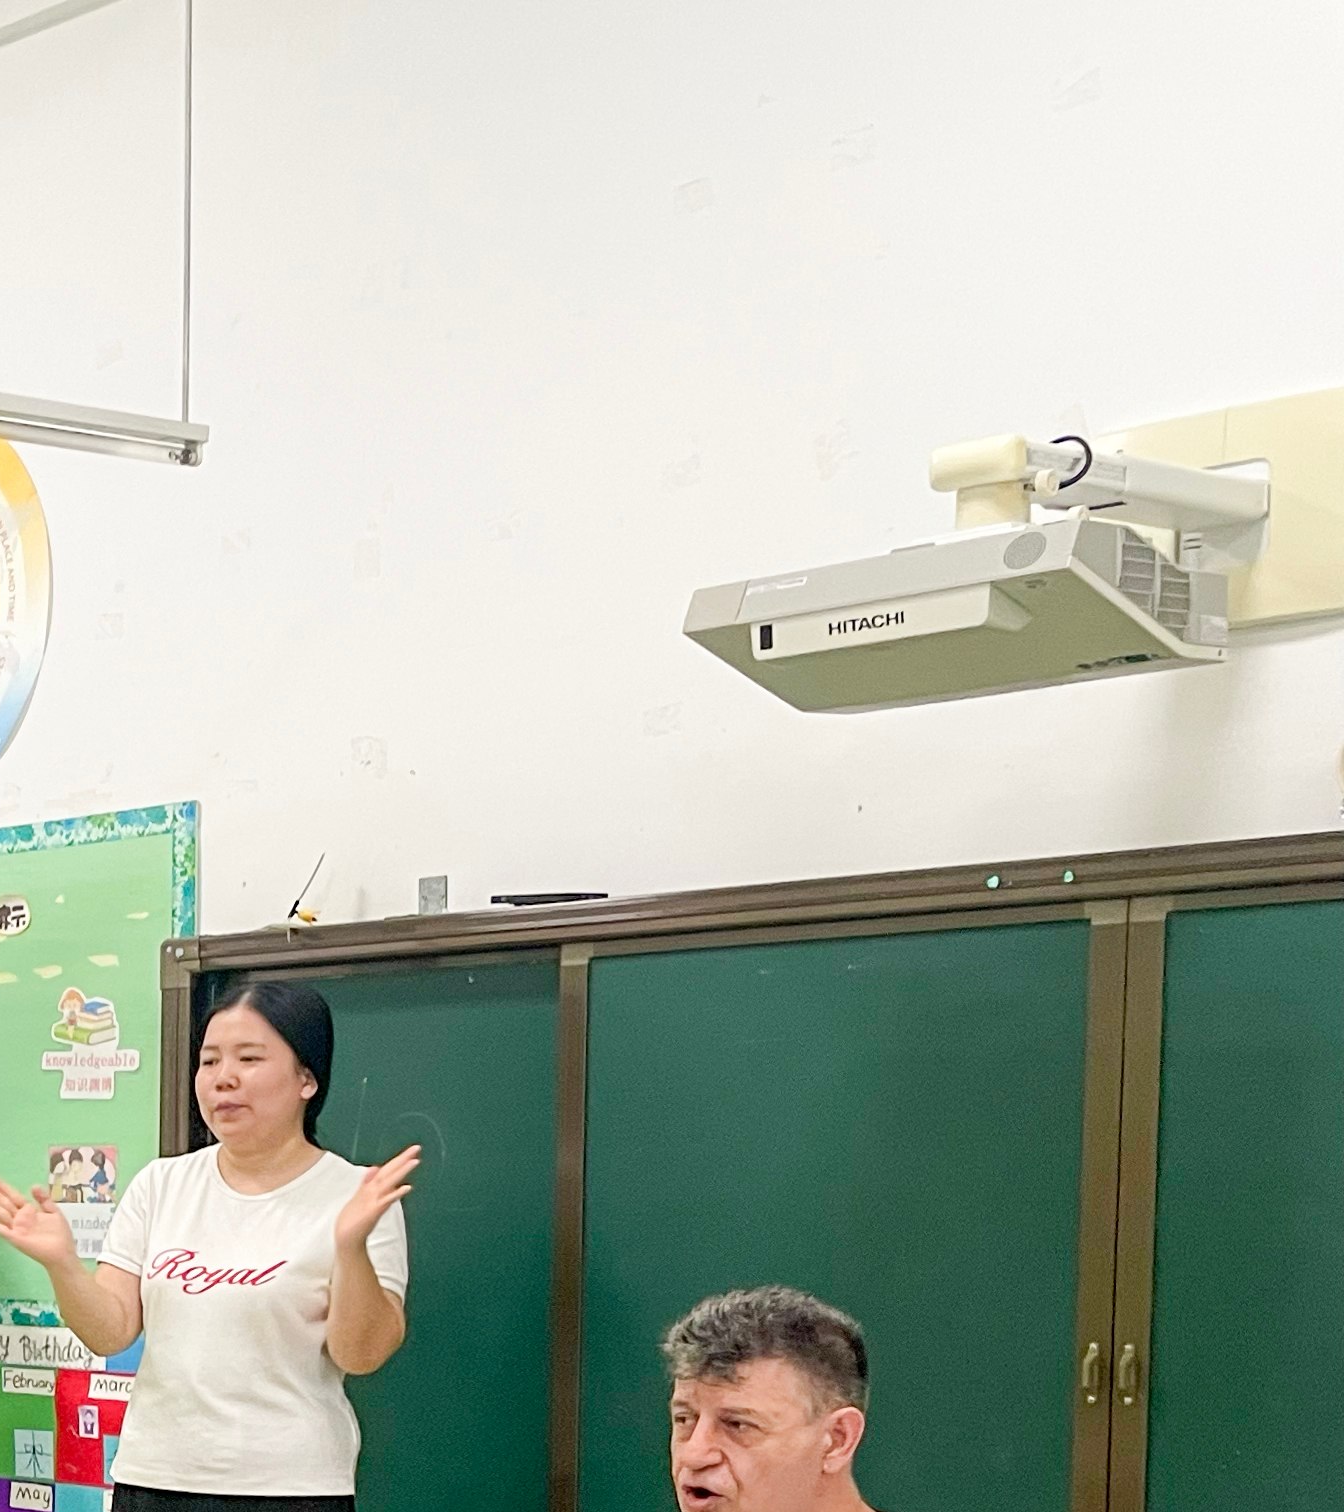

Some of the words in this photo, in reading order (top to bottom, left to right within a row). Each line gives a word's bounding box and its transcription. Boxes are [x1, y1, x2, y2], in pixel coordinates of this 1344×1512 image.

[828, 610, 904, 636] HITACHI
[146, 1248, 288, 1295] Royal
[3, 1368, 55, 1393] February
[93, 1379, 132, 1393] Marc
[15, 1486, 51, 1509] May
